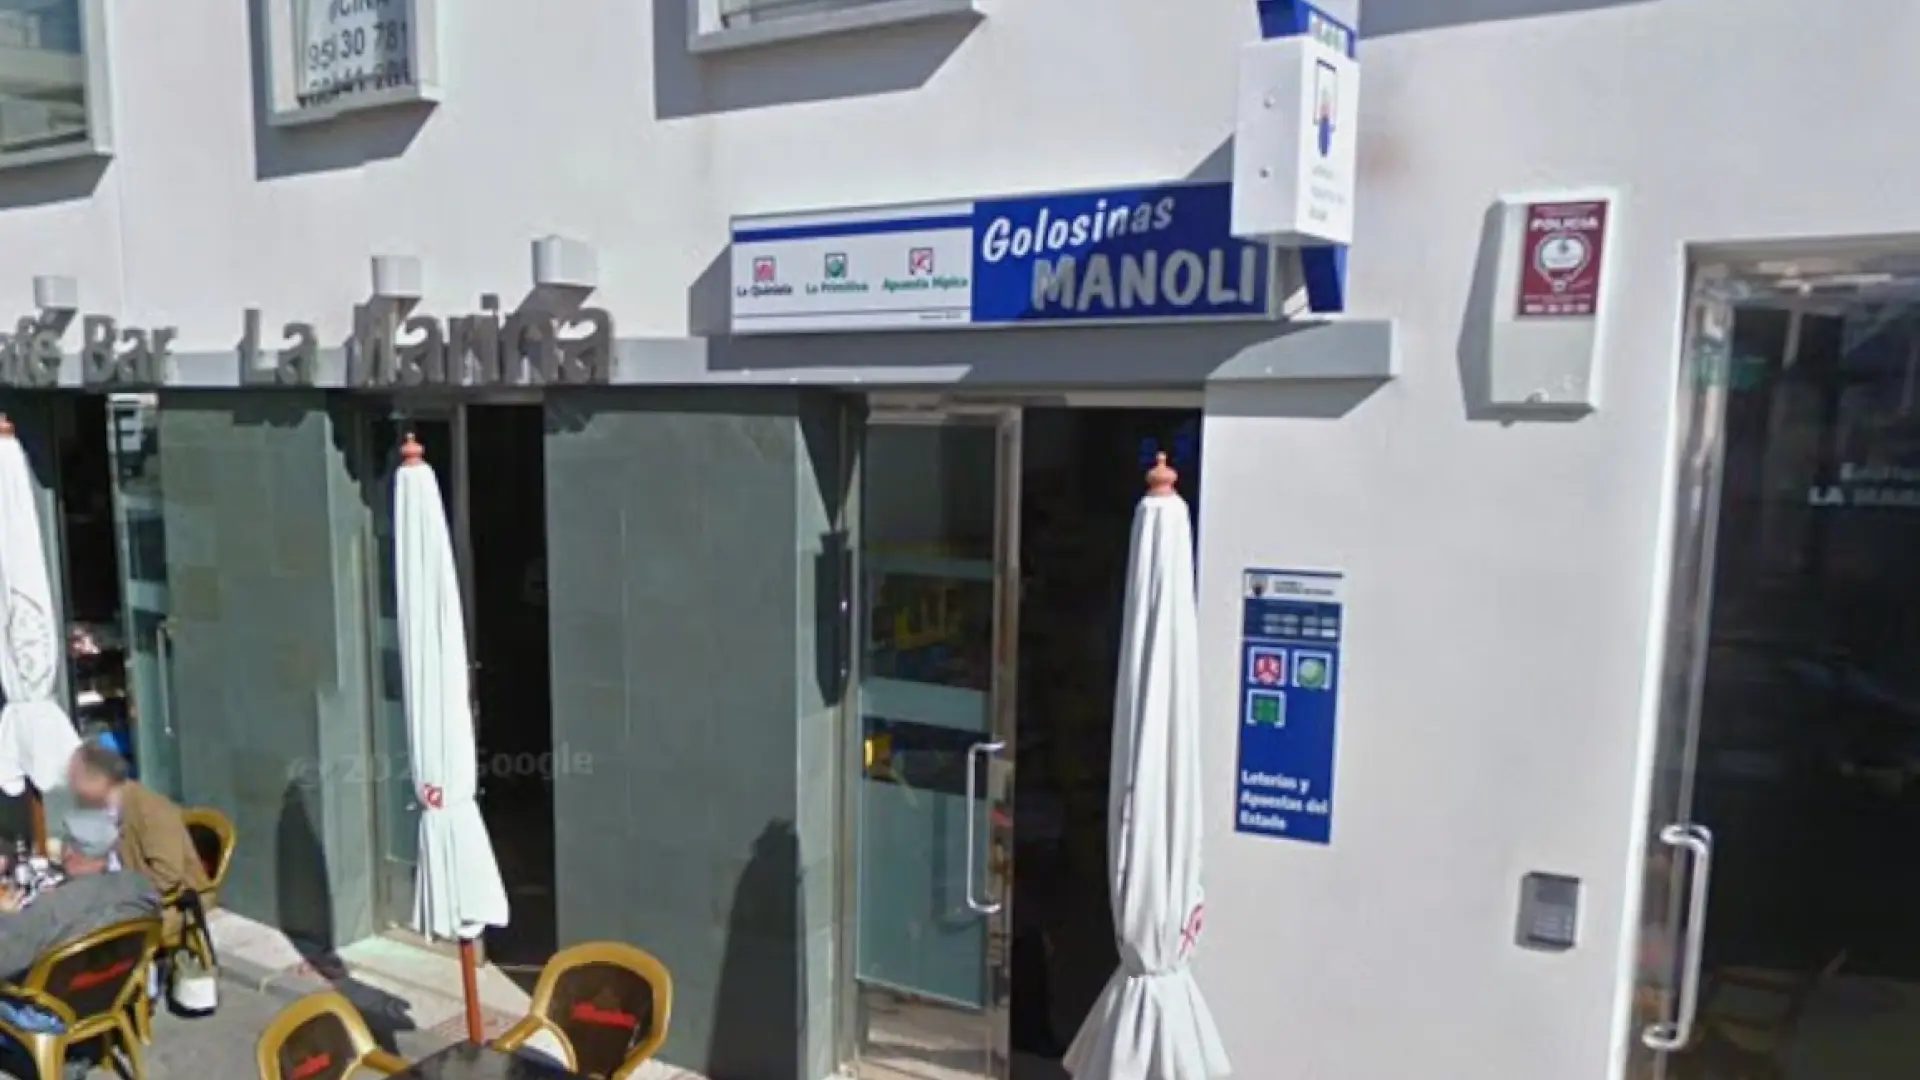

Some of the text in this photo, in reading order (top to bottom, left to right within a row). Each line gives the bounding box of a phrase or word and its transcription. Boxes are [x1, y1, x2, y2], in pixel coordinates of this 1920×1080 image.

[341, 26, 364, 58] 30
[982, 196, 1175, 262] Golosinas
[1032, 246, 1257, 311] MANOLI
[82, 314, 177, 387] Bar
[237, 309, 313, 386] La
[1300, 778, 1310, 795] y
[1240, 810, 1287, 830] Estado
[1306, 797, 1328, 814] del
